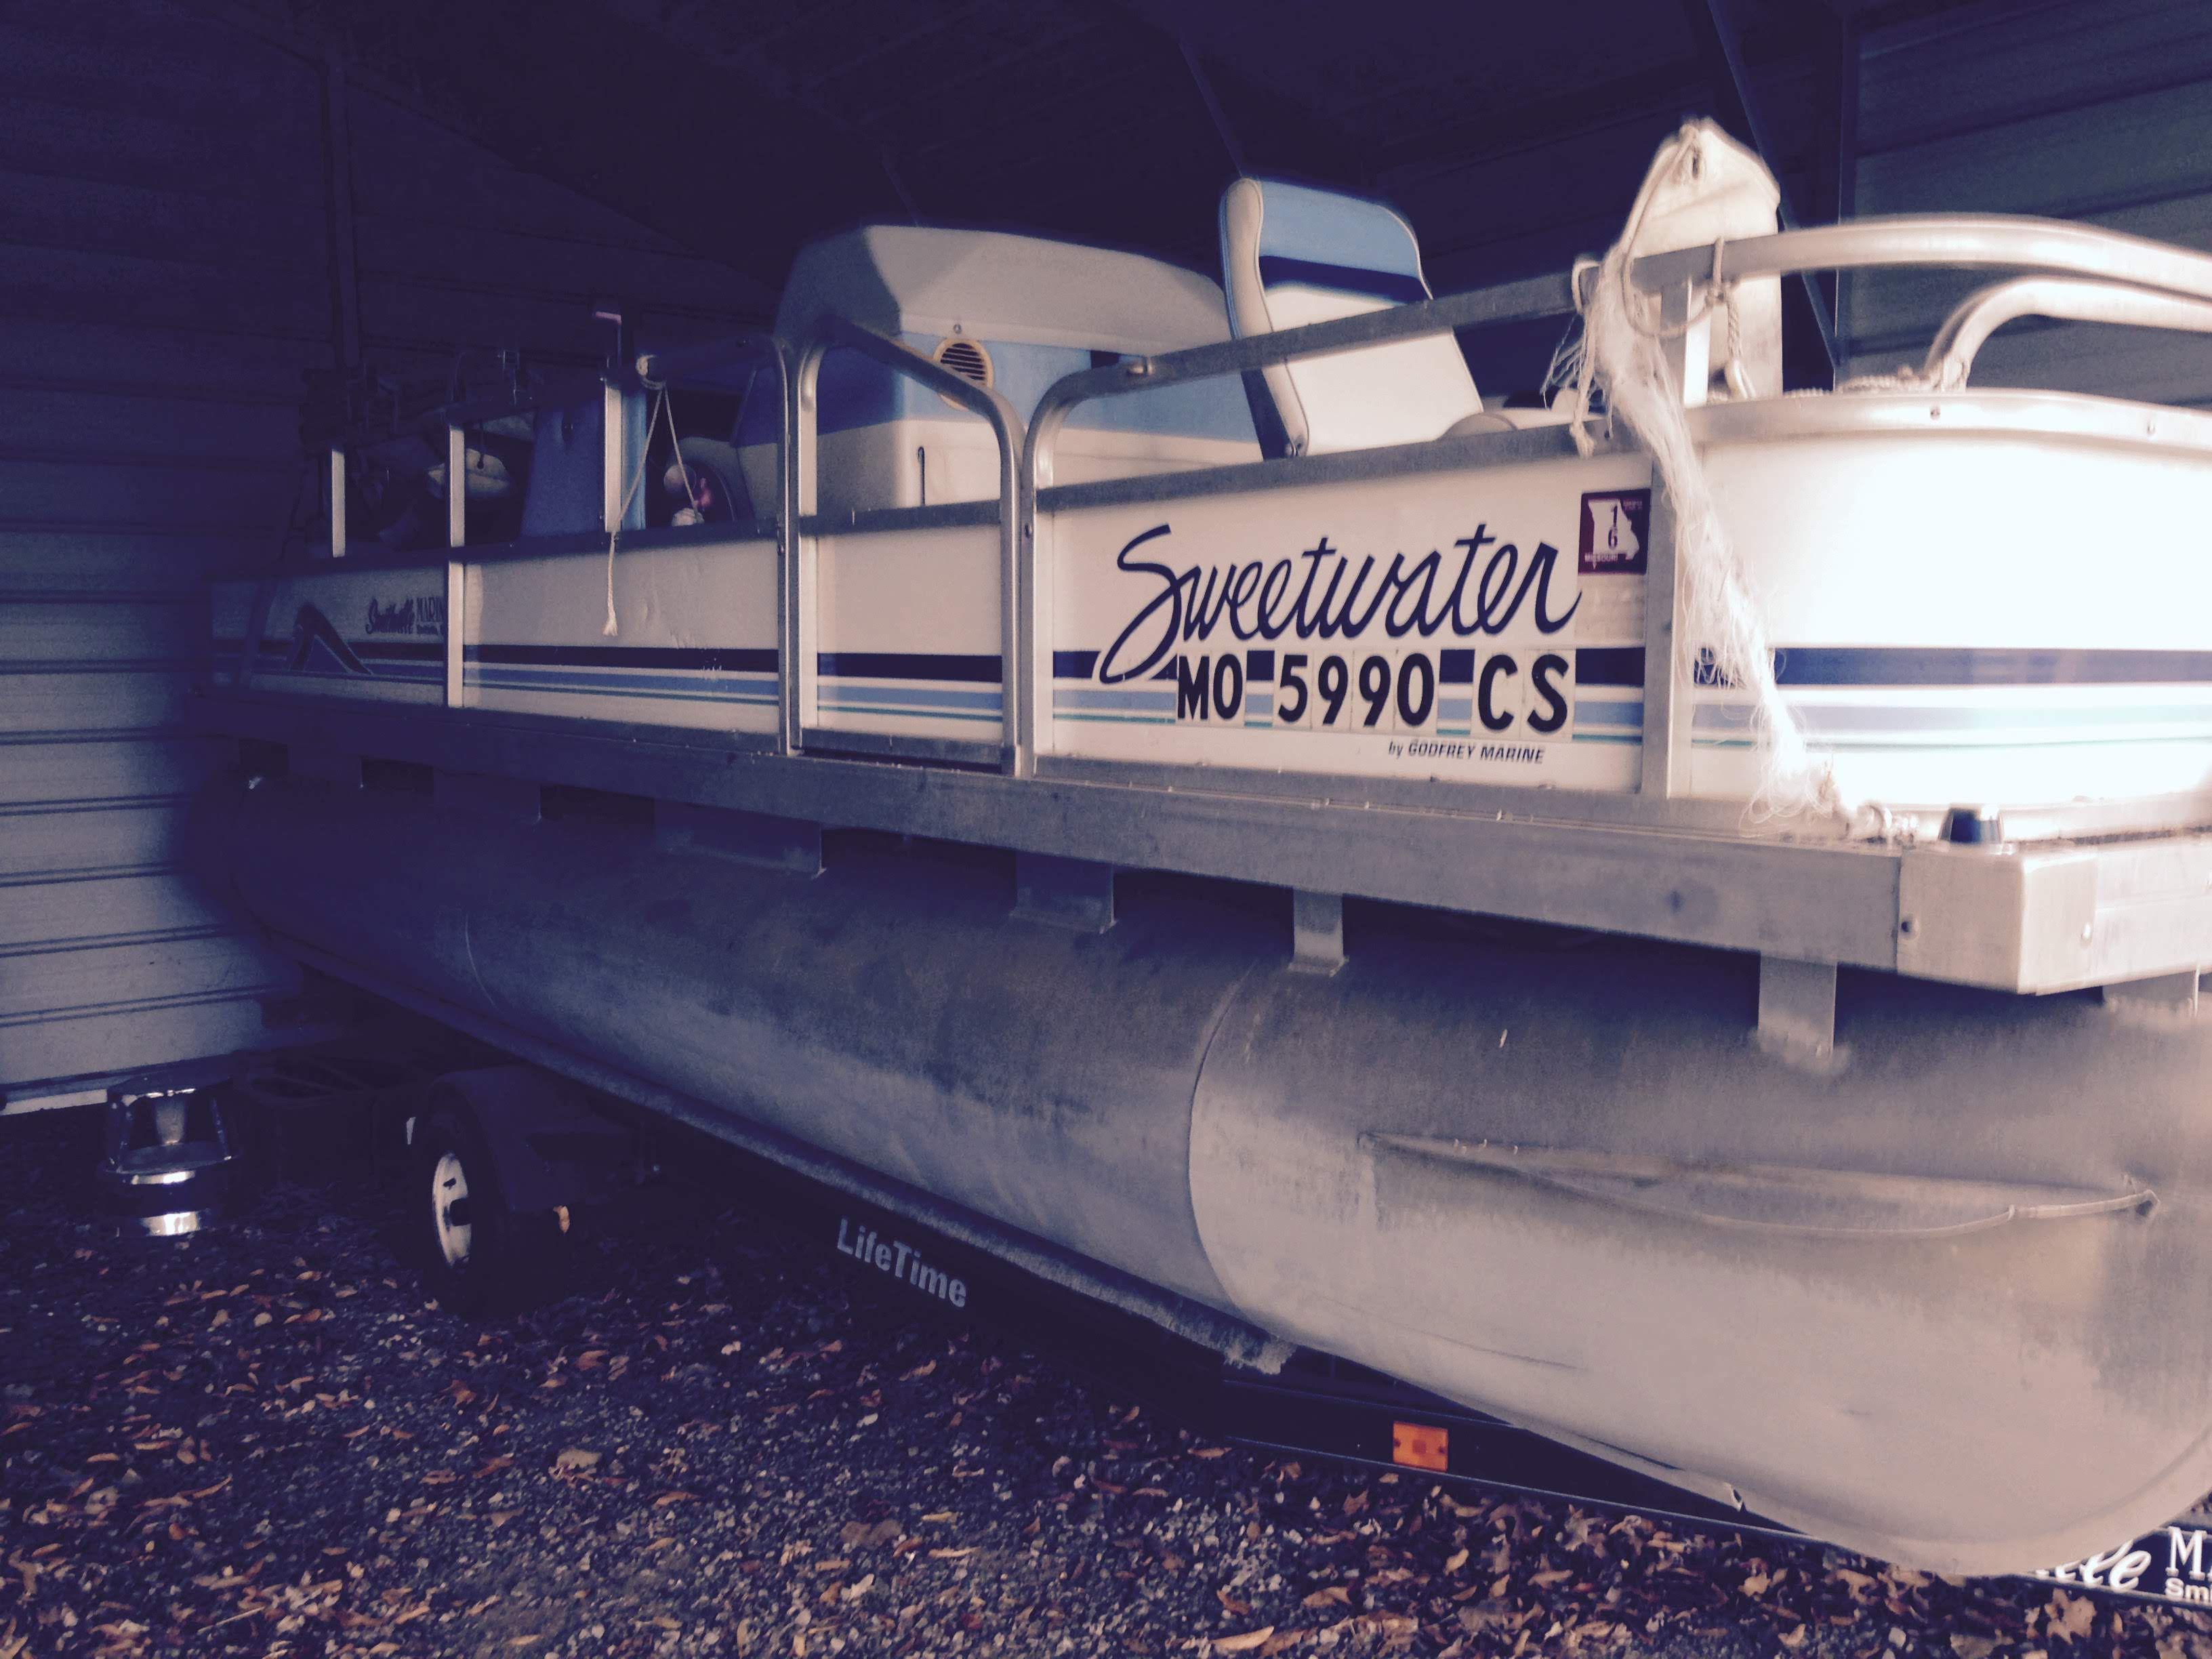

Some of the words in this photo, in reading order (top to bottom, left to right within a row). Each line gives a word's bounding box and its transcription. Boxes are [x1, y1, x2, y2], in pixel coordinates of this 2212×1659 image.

[1099, 522, 1582, 684] Sweetwater
[1177, 654, 1244, 720] MO
[1277, 652, 1435, 727] 5990
[1477, 653, 1570, 734] CS
[1389, 741, 1403, 758] by
[1408, 741, 1474, 760] GODFREY
[1480, 745, 1544, 764] MARINE
[836, 1217, 967, 1307] LifeTime
